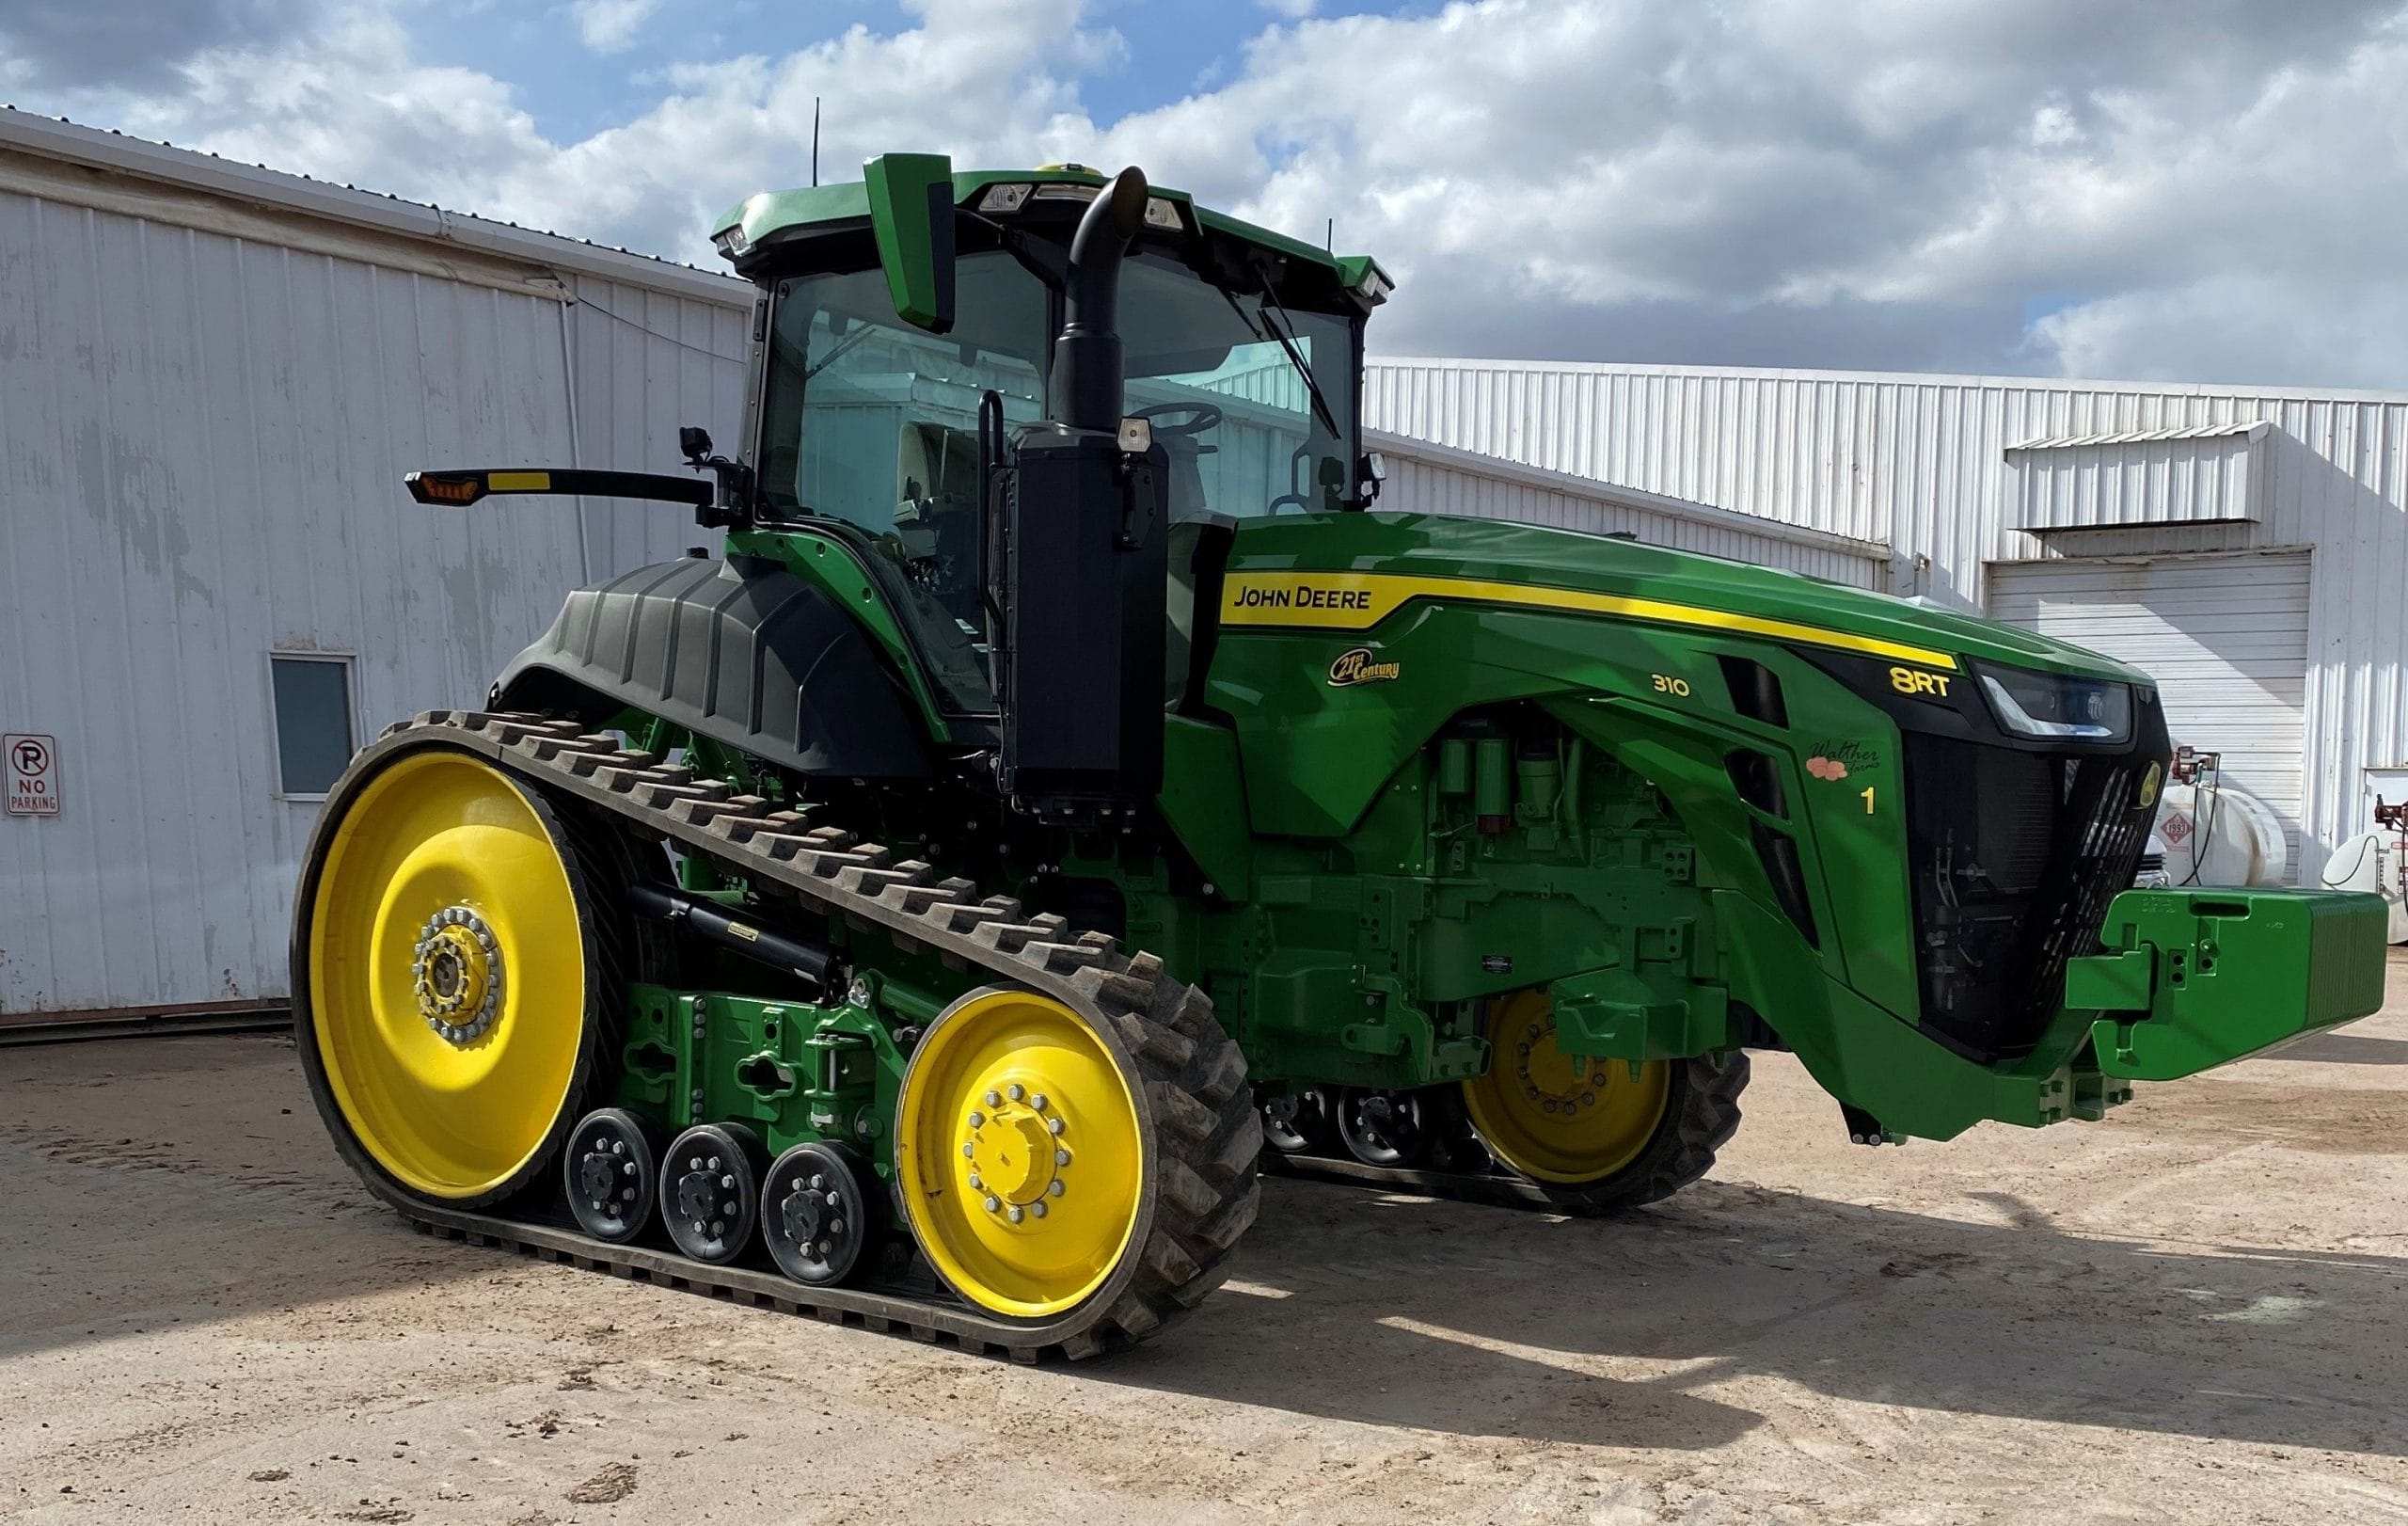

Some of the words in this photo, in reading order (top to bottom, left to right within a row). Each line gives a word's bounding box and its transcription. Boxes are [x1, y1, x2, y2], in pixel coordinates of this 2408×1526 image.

[1233, 585, 1291, 607] JOHN
[1295, 585, 1371, 610] DEERE
[1651, 674, 1690, 697] 310
[1890, 666, 1950, 697] 8RT
[19, 779, 45, 794] NO
[11, 796, 56, 810] PARKING
[1861, 787, 1876, 815] 1
